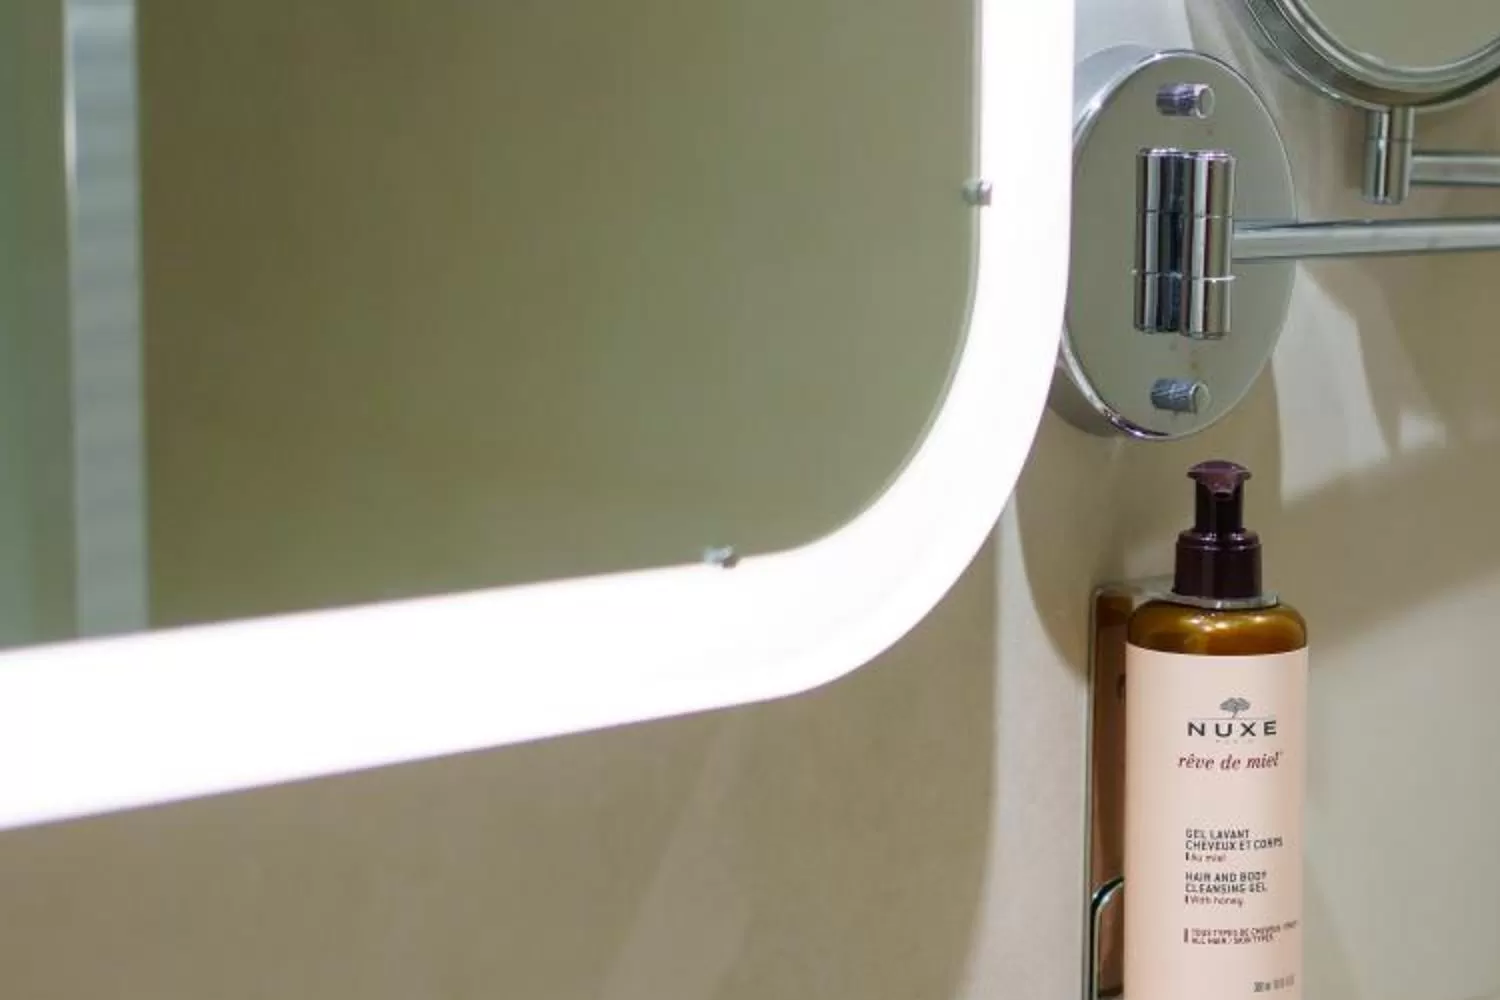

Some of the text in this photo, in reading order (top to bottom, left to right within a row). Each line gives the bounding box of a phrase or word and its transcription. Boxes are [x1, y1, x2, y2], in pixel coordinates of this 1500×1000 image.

[1187, 720, 1277, 737] NUXE
[1177, 752, 1279, 769] rêve de miel
[1185, 828, 1250, 839] GEL LAVANT
[1185, 836, 1283, 851] CHEVEUX ET CORPS
[1185, 870, 1267, 882] HAIR AND BODY
[1185, 881, 1267, 893] CLEANSING GEL
[1213, 895, 1244, 907] honey
